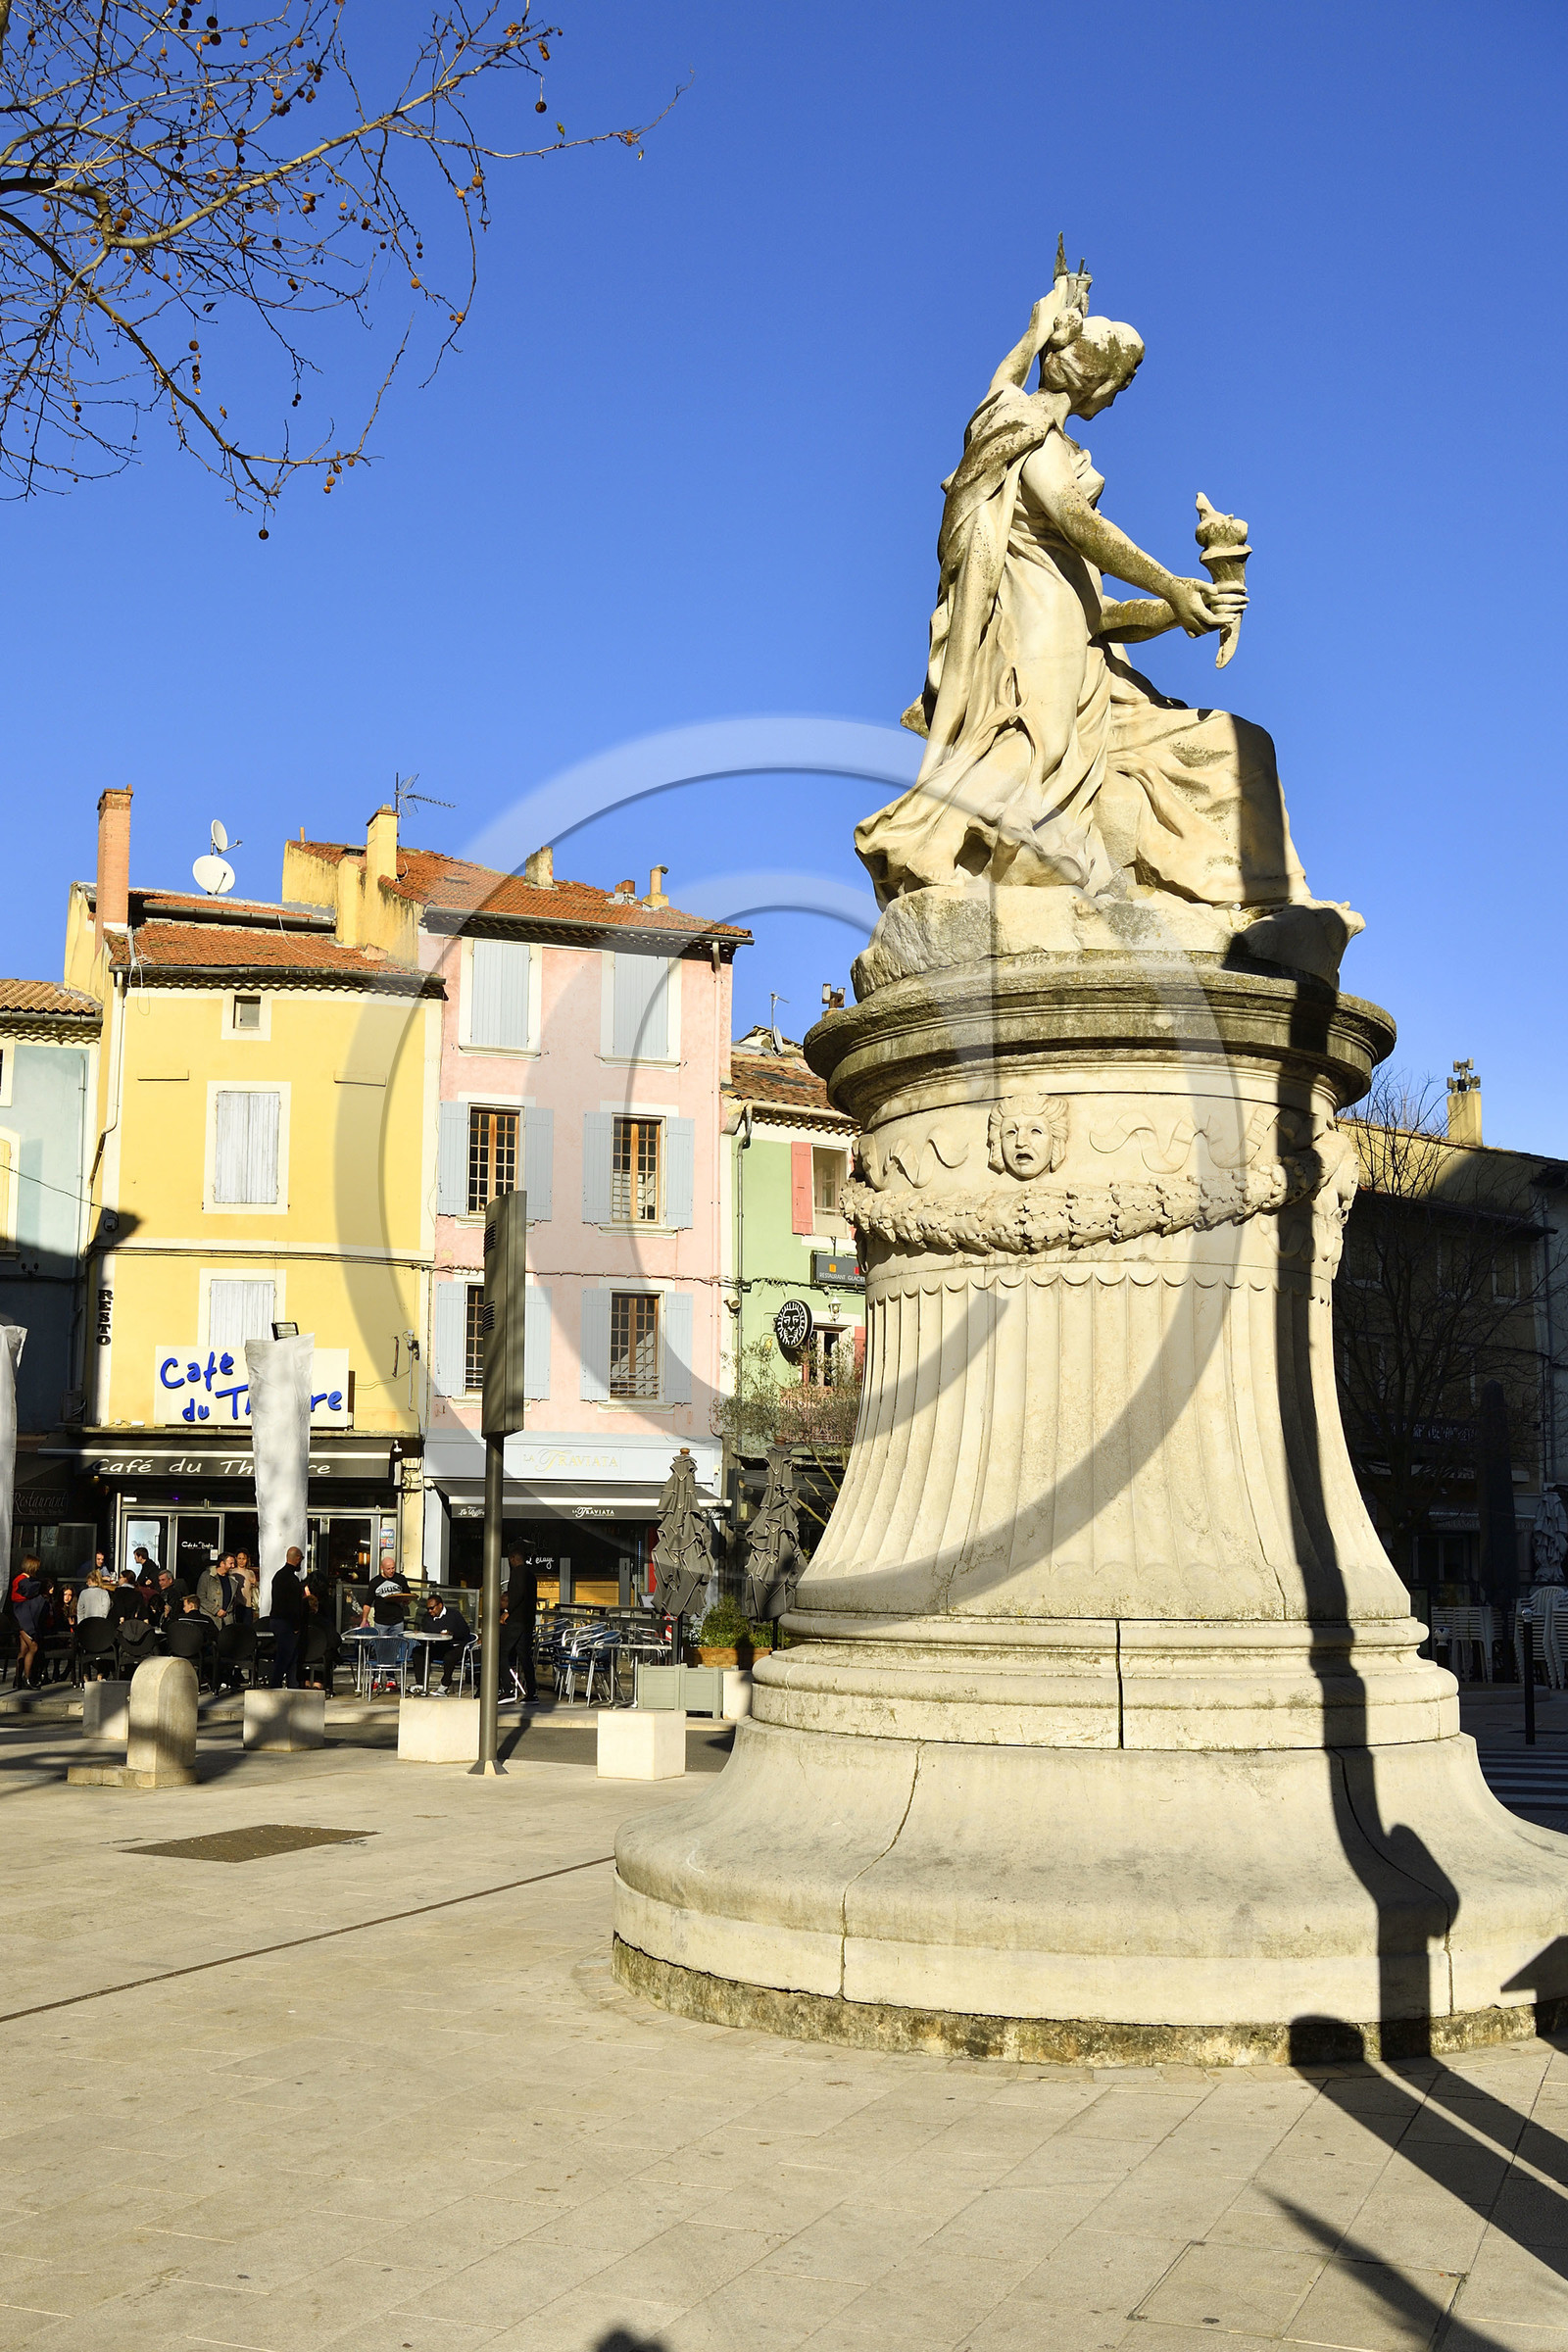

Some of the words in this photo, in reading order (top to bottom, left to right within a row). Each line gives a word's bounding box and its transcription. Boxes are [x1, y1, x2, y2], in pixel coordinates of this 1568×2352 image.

[96, 1289, 114, 1346] RESTO
[182, 1397, 210, 1421] du
[92, 1458, 152, 1473] Café
[169, 1458, 201, 1473] du
